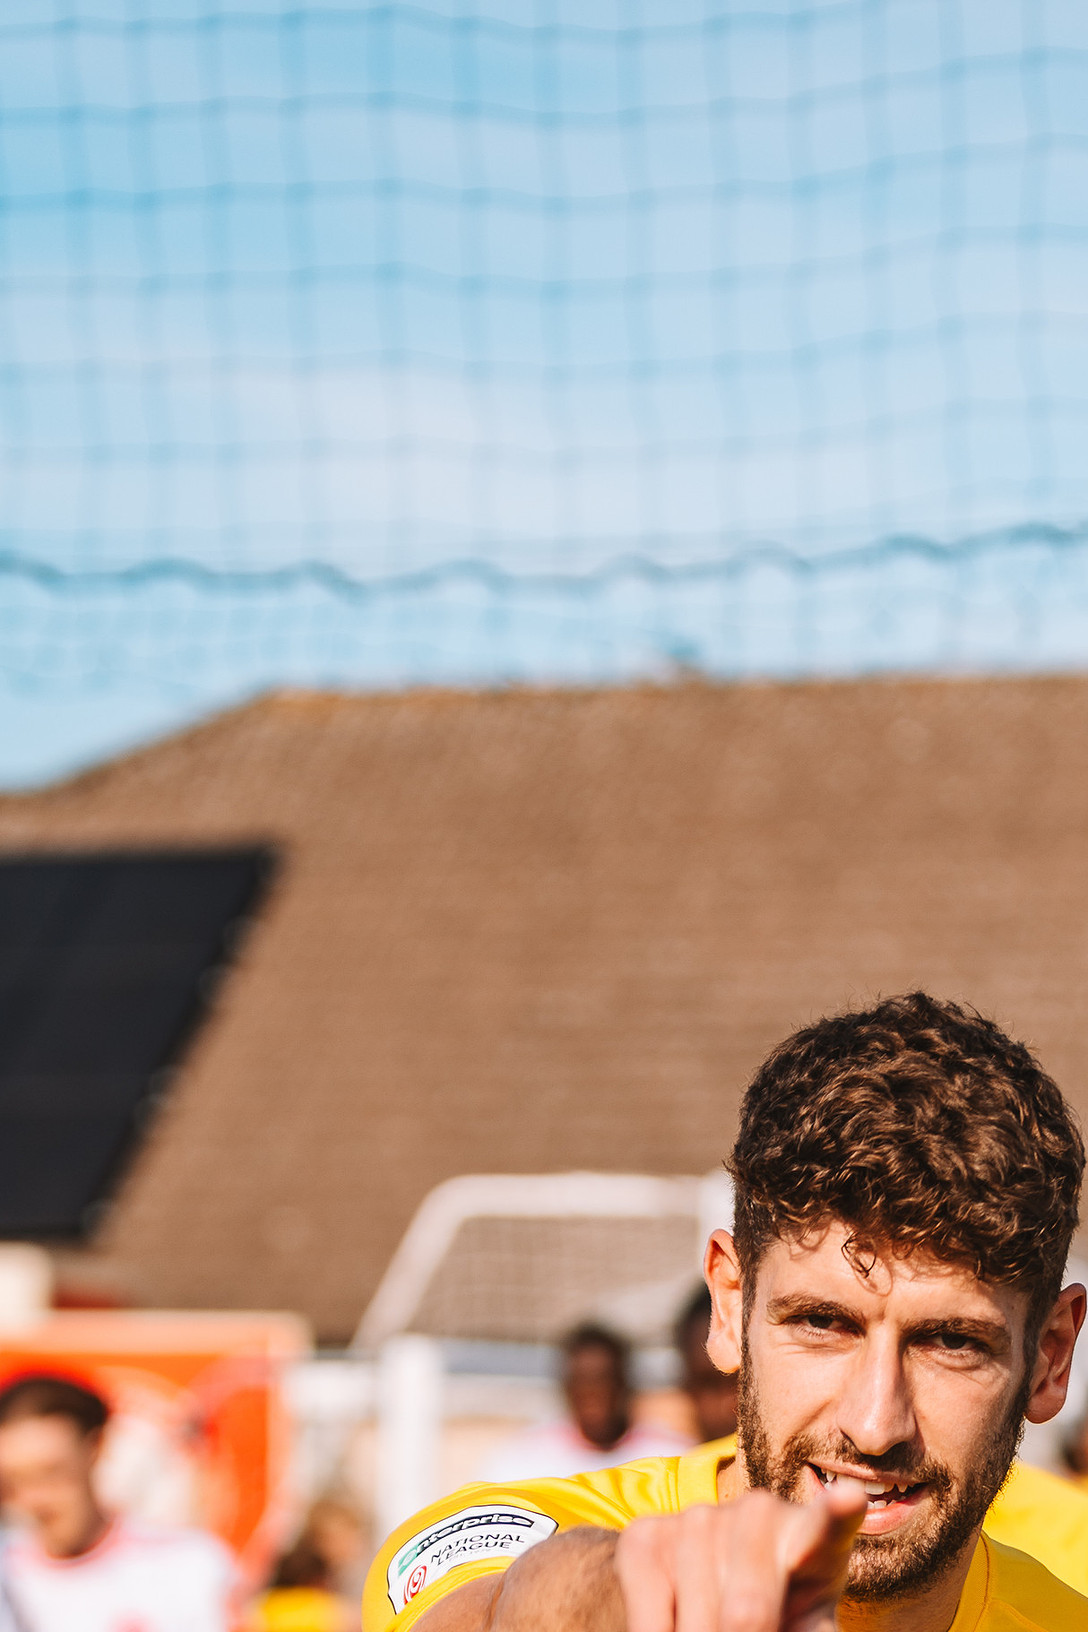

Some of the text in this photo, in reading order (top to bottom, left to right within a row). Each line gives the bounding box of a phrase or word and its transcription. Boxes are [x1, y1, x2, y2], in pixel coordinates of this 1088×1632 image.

[400, 1514, 532, 1570] enterprise
[431, 1534, 525, 1563] NATIONAL
[437, 1542, 512, 1566] LEAGUE
